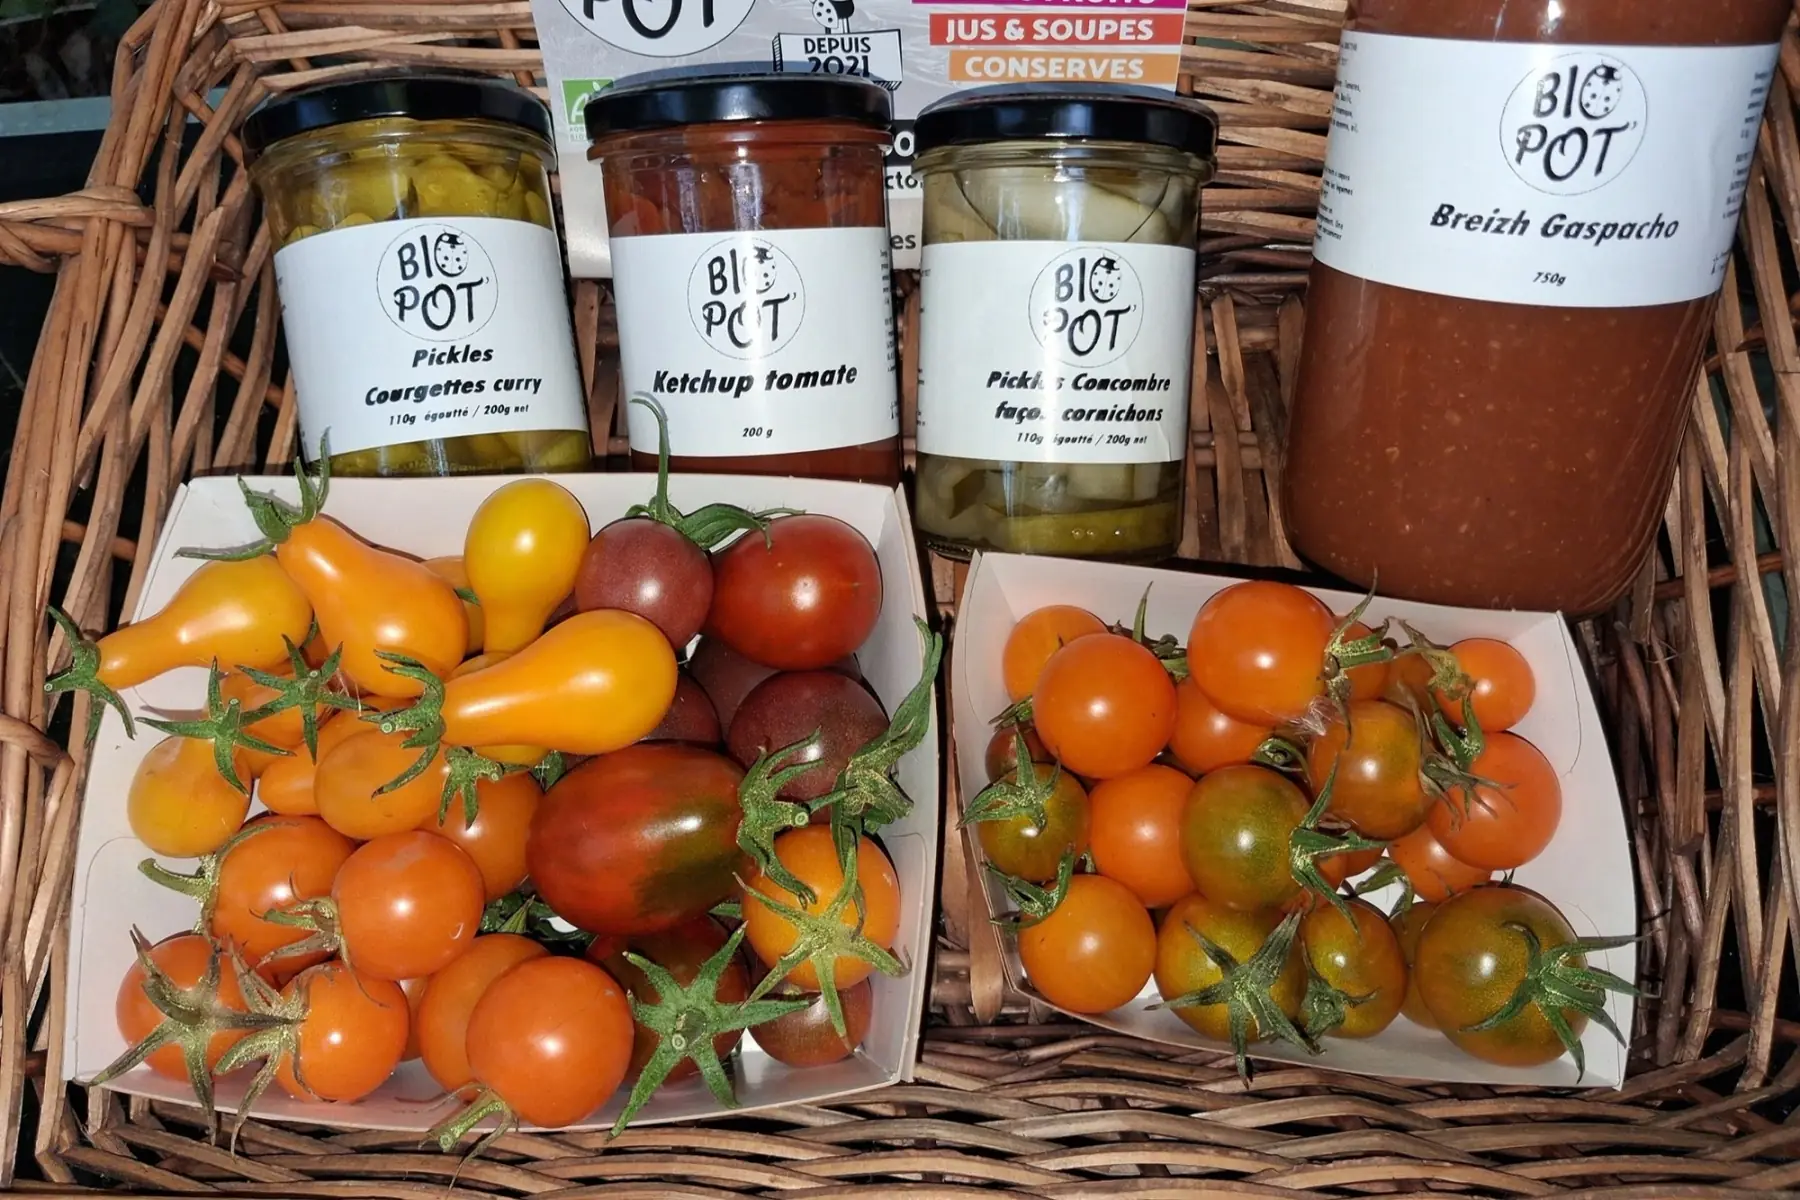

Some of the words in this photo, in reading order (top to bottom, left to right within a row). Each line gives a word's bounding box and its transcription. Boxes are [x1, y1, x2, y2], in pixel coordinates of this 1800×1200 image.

[946, 19, 997, 43] JUS
[1004, 19, 1024, 40] &
[1033, 19, 1154, 41] SOUPES
[803, 37, 871, 54] DEPUIS
[808, 55, 869, 77] 2021
[965, 56, 1144, 79] CONSERVES
[1430, 203, 1531, 237] Breizh
[1540, 213, 1680, 247] Gaspacho
[1533, 272, 1567, 287] 750g
[412, 344, 494, 368] Pickles
[365, 379, 486, 407] Courgettes
[493, 378, 542, 394] curry
[653, 369, 754, 399] Ketchup
[764, 364, 858, 391] tomate
[1071, 372, 1170, 392] Concombre
[389, 414, 416, 426] 110g
[424, 407, 468, 423] égoutté
[484, 404, 510, 416] 200g
[514, 404, 529, 414] net
[1061, 403, 1163, 422] cornichons
[742, 427, 763, 438] 200
[766, 428, 773, 439] g
[1106, 434, 1131, 447] 200g
